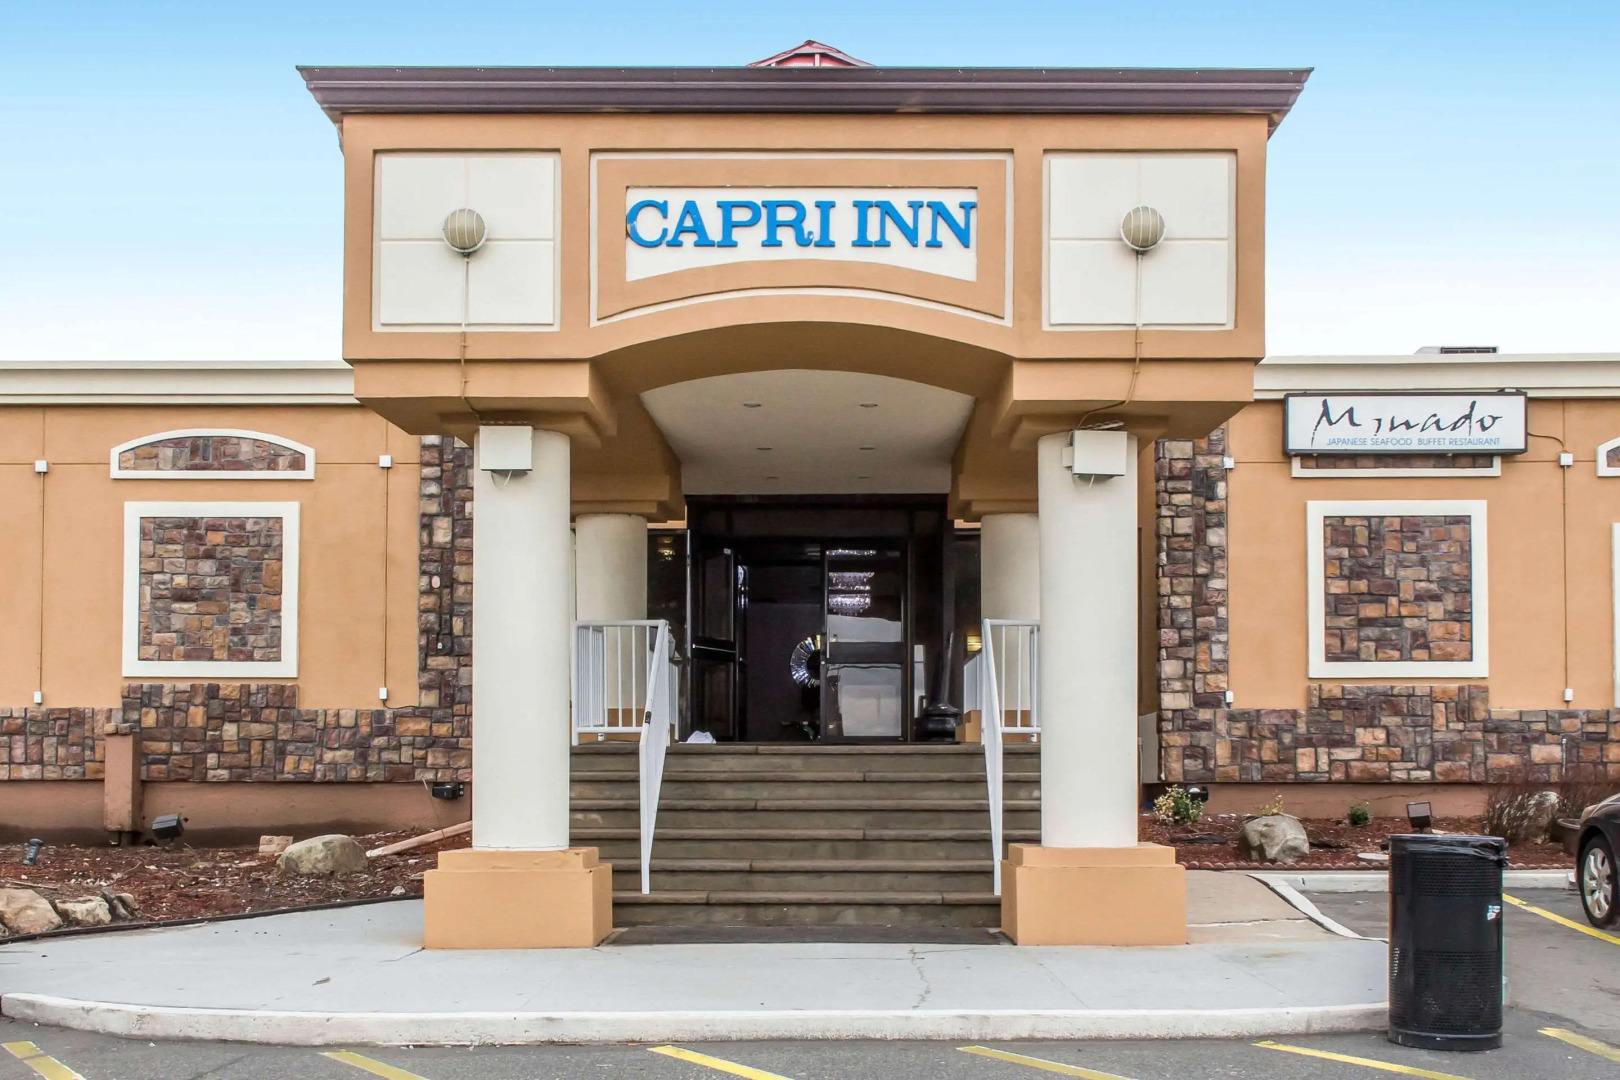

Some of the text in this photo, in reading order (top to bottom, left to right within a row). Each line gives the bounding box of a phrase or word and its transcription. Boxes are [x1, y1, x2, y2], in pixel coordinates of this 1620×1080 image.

[626, 199, 977, 248] CAPRI INN
[1311, 398, 1503, 447] Minado
[1326, 437, 1500, 446] JAPANESE SEAFOOD BUFFET RESTAURANT
